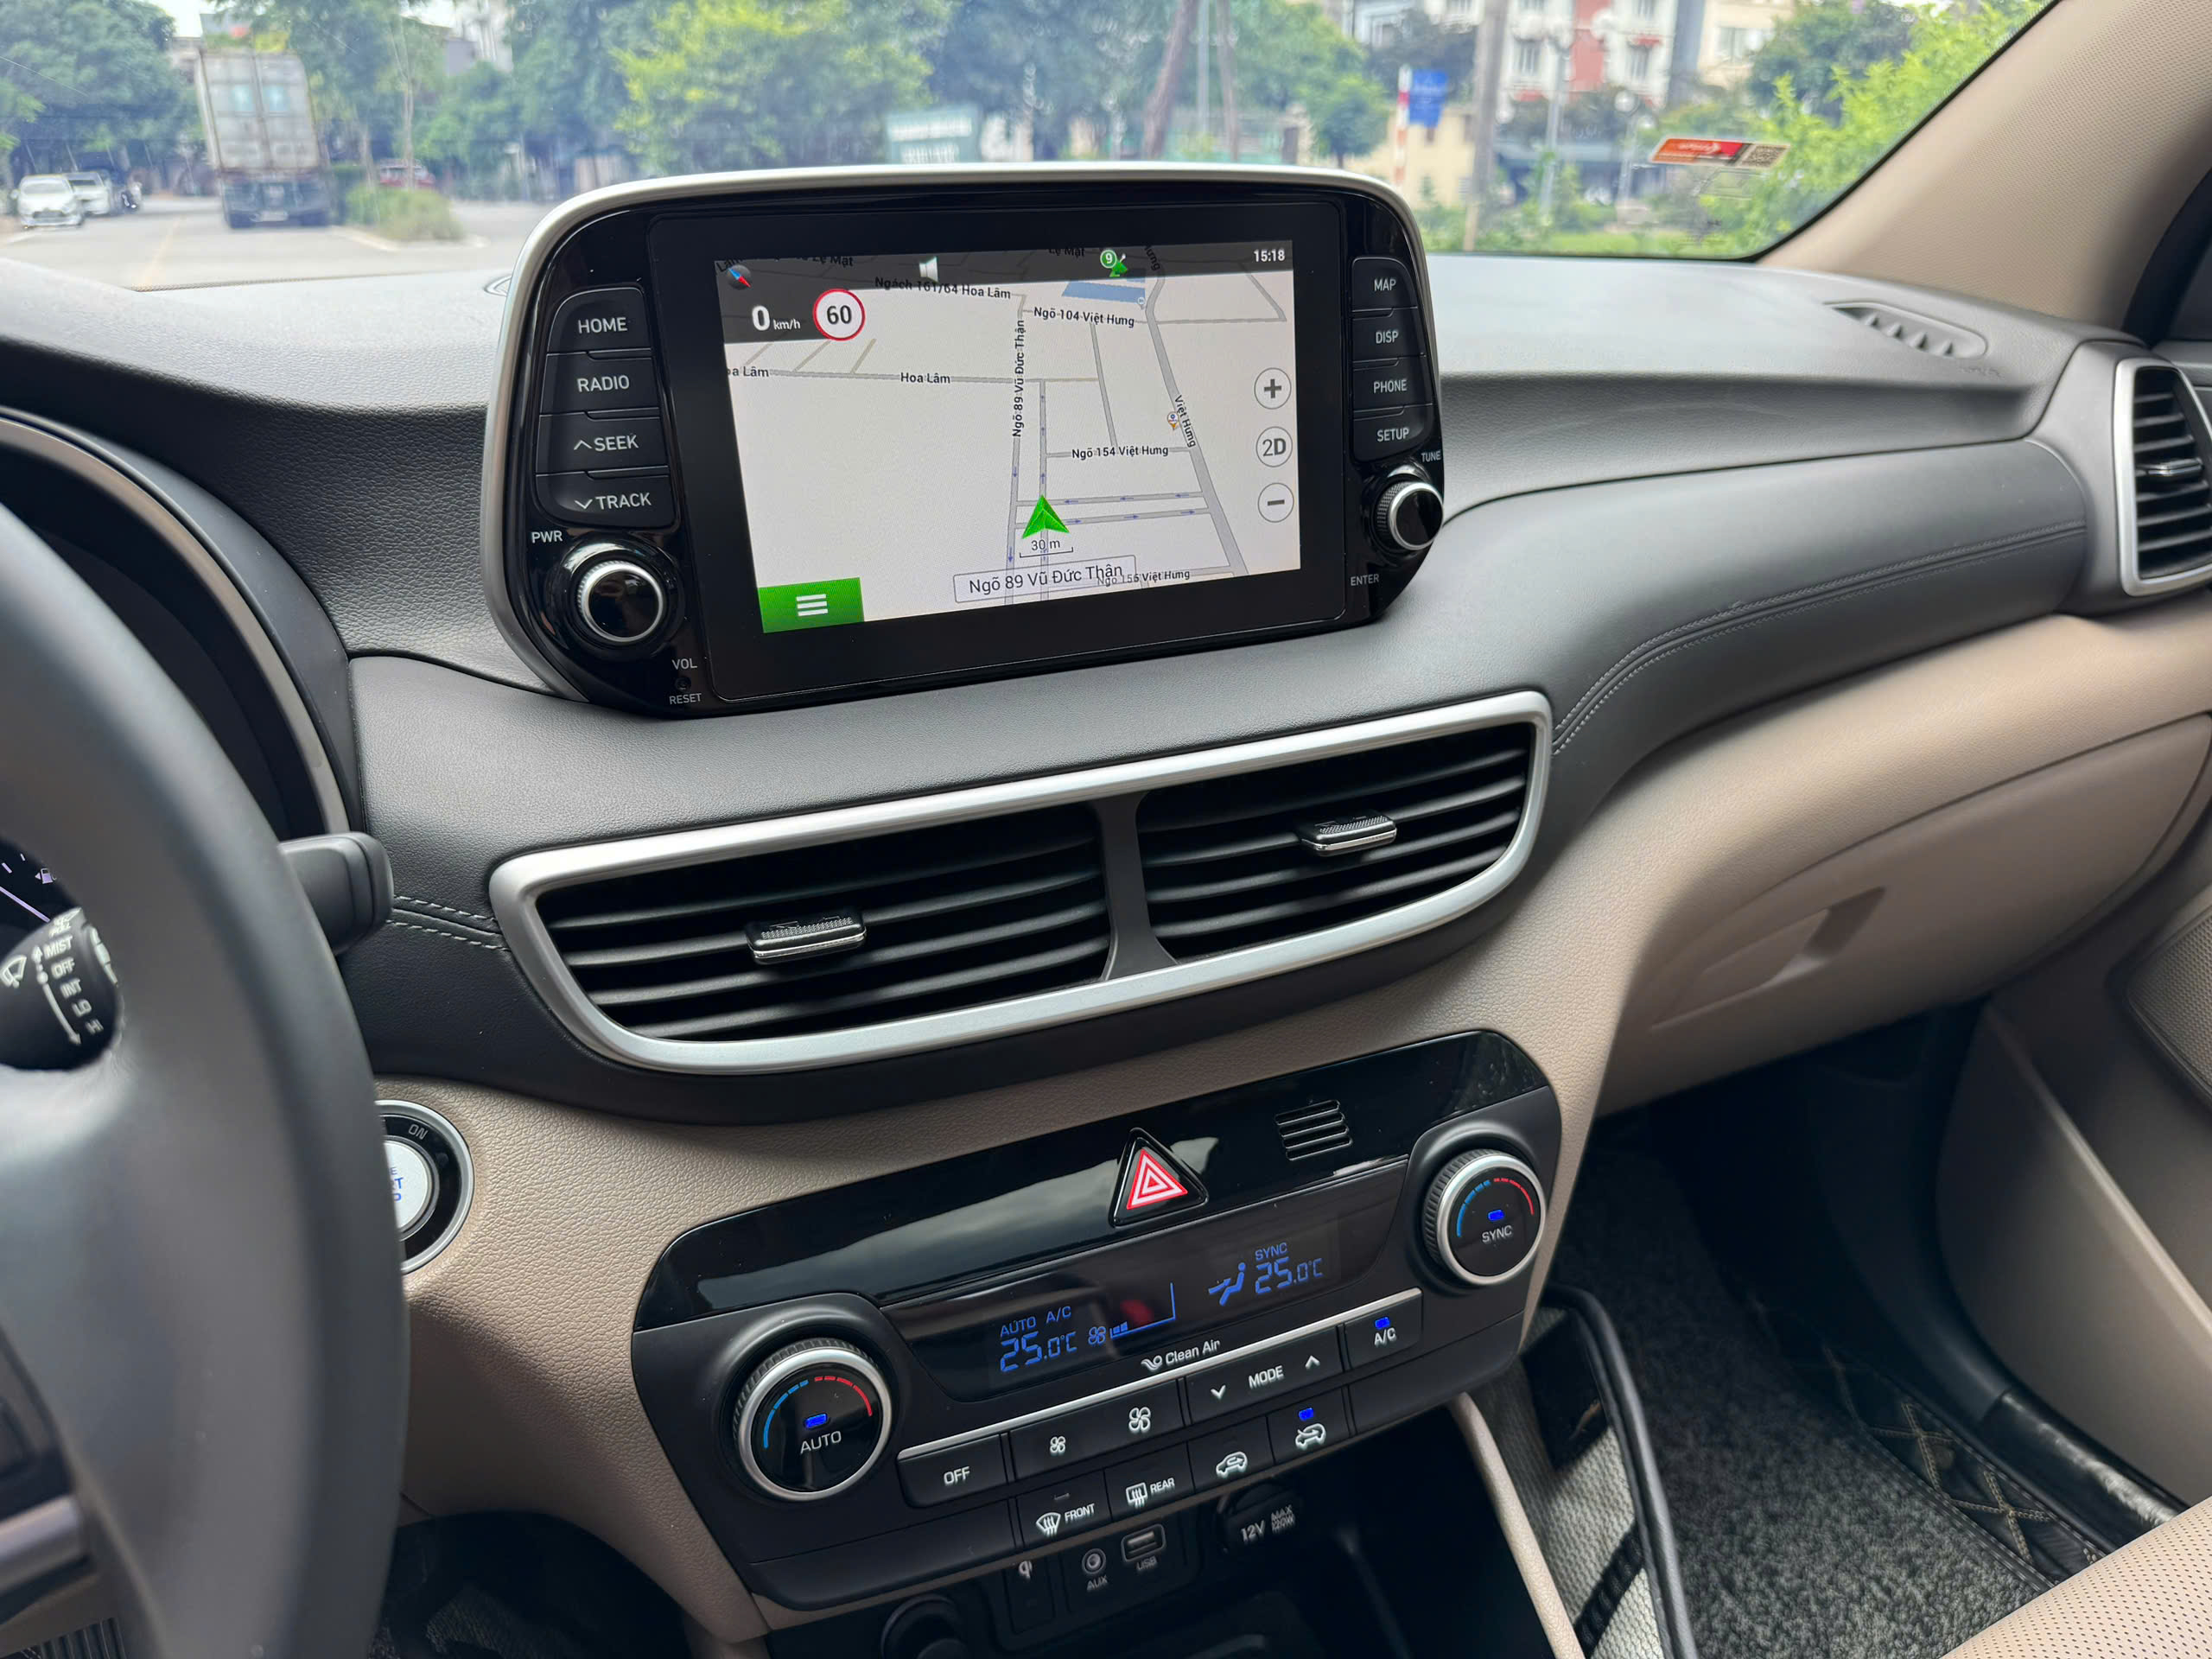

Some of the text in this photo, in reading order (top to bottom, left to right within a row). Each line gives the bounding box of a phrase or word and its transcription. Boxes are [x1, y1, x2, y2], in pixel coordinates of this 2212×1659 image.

[1254, 250, 1286, 263] 15:18
[874, 276, 913, 290] Ngách
[962, 284, 984, 297] Hoa
[987, 287, 1011, 299] Lâm
[1373, 278, 1396, 292] MAP
[751, 305, 801, 332] 0 km/h
[826, 305, 853, 325] 60
[1033, 307, 1135, 327] Ngõ 104 Việt Hưng
[577, 316, 628, 334] HOME
[1375, 330, 1399, 343] DISP
[1014, 351, 1025, 374] Đức
[742, 366, 770, 378] Lâm
[900, 372, 951, 385] Hoa Lâm
[576, 374, 630, 392] RADIO
[1014, 378, 1024, 394] Vũ
[1372, 378, 1408, 394] PHONE
[1014, 397, 1024, 411] 89
[1012, 416, 1025, 438] Ngõ
[1174, 394, 1197, 448] Việt Hưng
[594, 434, 639, 451] SEEK
[1376, 427, 1410, 442] SETUP
[1071, 444, 1169, 461] Ngõ 154 Việt Hưng
[1262, 437, 1287, 457] 2D
[1421, 450, 1442, 463] TUNE
[595, 492, 652, 510] TRACK
[531, 530, 563, 543] PWR
[1031, 539, 1061, 551] 30 m
[969, 576, 1001, 596] Ngõ
[1004, 574, 1024, 589] 89
[1027, 570, 1049, 587] Vũ
[1052, 568, 1082, 584] Đức
[1142, 571, 1162, 583] Việt
[1164, 570, 1191, 582] Hưng
[1350, 573, 1380, 587] ENTER
[671, 658, 698, 671] VOL
[669, 692, 702, 705] RESET
[44, 935, 73, 961] MIST
[51, 957, 76, 979] OFF
[60, 978, 82, 999] INT
[85, 1019, 105, 1035] HI
[408, 1124, 429, 1141] ON
[1481, 1224, 1513, 1244] SYNC
[1255, 1242, 1287, 1262] SYNC
[1000, 1306, 1072, 1338] AUTO A/C
[1374, 1327, 1397, 1347] A/C
[1165, 1338, 1221, 1365] Clean Air
[1248, 1364, 1285, 1389] MODE
[800, 1430, 842, 1454] AUTO
[943, 1466, 971, 1486] OFF
[1149, 1477, 1176, 1494] REAR
[1064, 1503, 1096, 1522] FRONT
[1240, 1519, 1265, 1542] 12V
[1085, 1573, 1109, 1592] AUX
